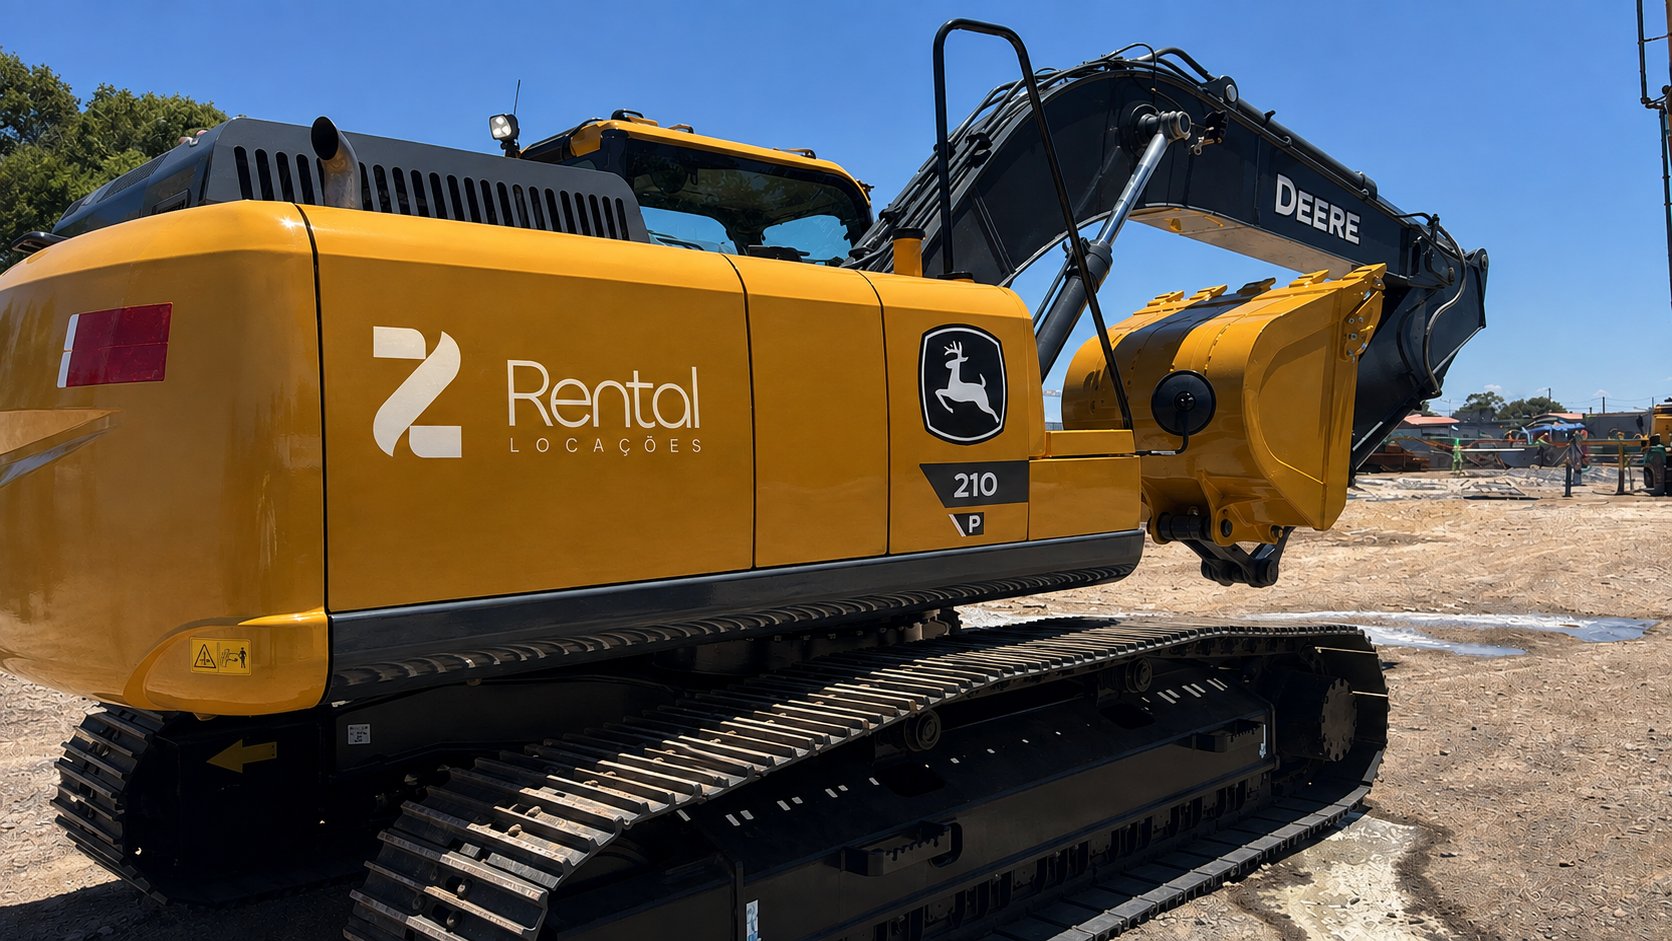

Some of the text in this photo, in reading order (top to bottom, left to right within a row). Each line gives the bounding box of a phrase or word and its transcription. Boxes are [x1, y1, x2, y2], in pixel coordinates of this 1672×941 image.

[1275, 173, 1360, 245] DEERE
[507, 359, 700, 429] Rental
[953, 472, 998, 498] 210
[969, 515, 981, 533] P
